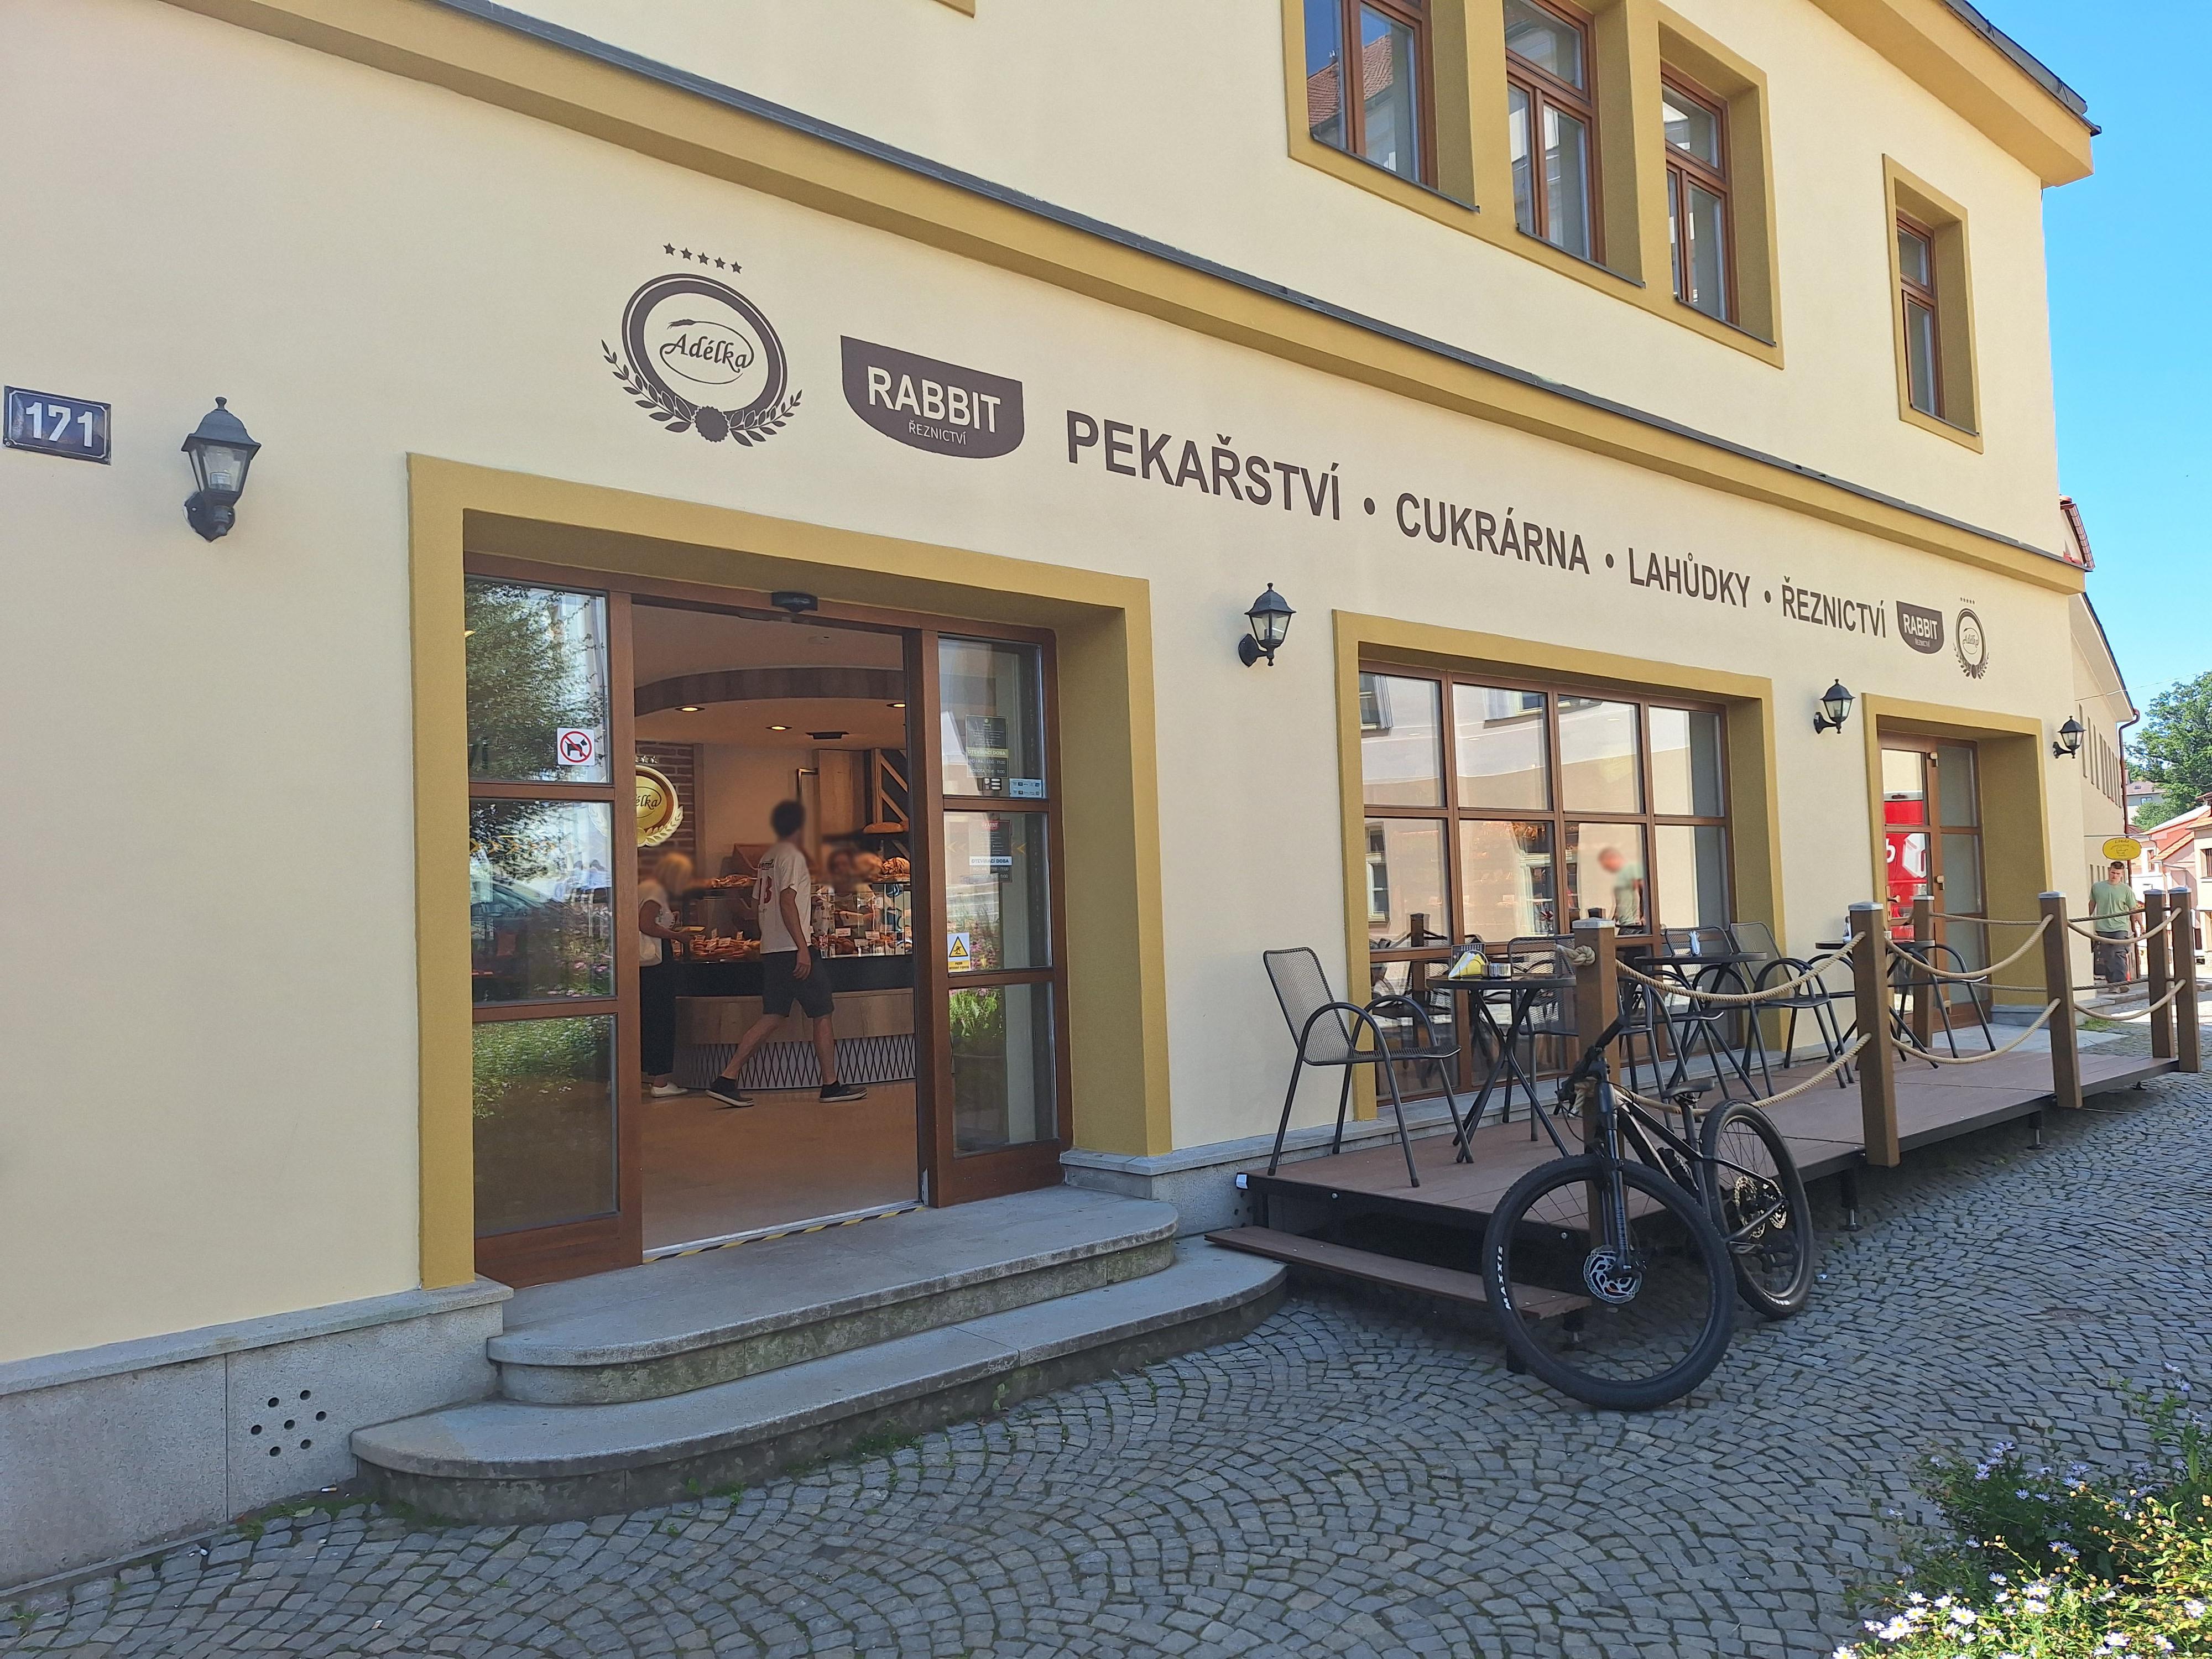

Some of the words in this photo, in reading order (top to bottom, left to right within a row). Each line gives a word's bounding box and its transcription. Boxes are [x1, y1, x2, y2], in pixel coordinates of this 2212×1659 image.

[665, 333, 750, 373] Adélka
[867, 366, 1001, 433] RABBIT
[26, 401, 93, 447] 171
[909, 420, 967, 446] ŘEZNICTVÍ
[1067, 410, 1340, 520] PEKAŘSTVÍ
[1396, 492, 1590, 575] CUKRÁRNA
[1629, 547, 1751, 608] LAHŮDKY
[1782, 575, 1886, 638] ŘEZNICTVÍ
[1903, 613, 1938, 640] RABBIT
[636, 795, 658, 810] élka
[1497, 1245, 1511, 1311] MAXXIS
